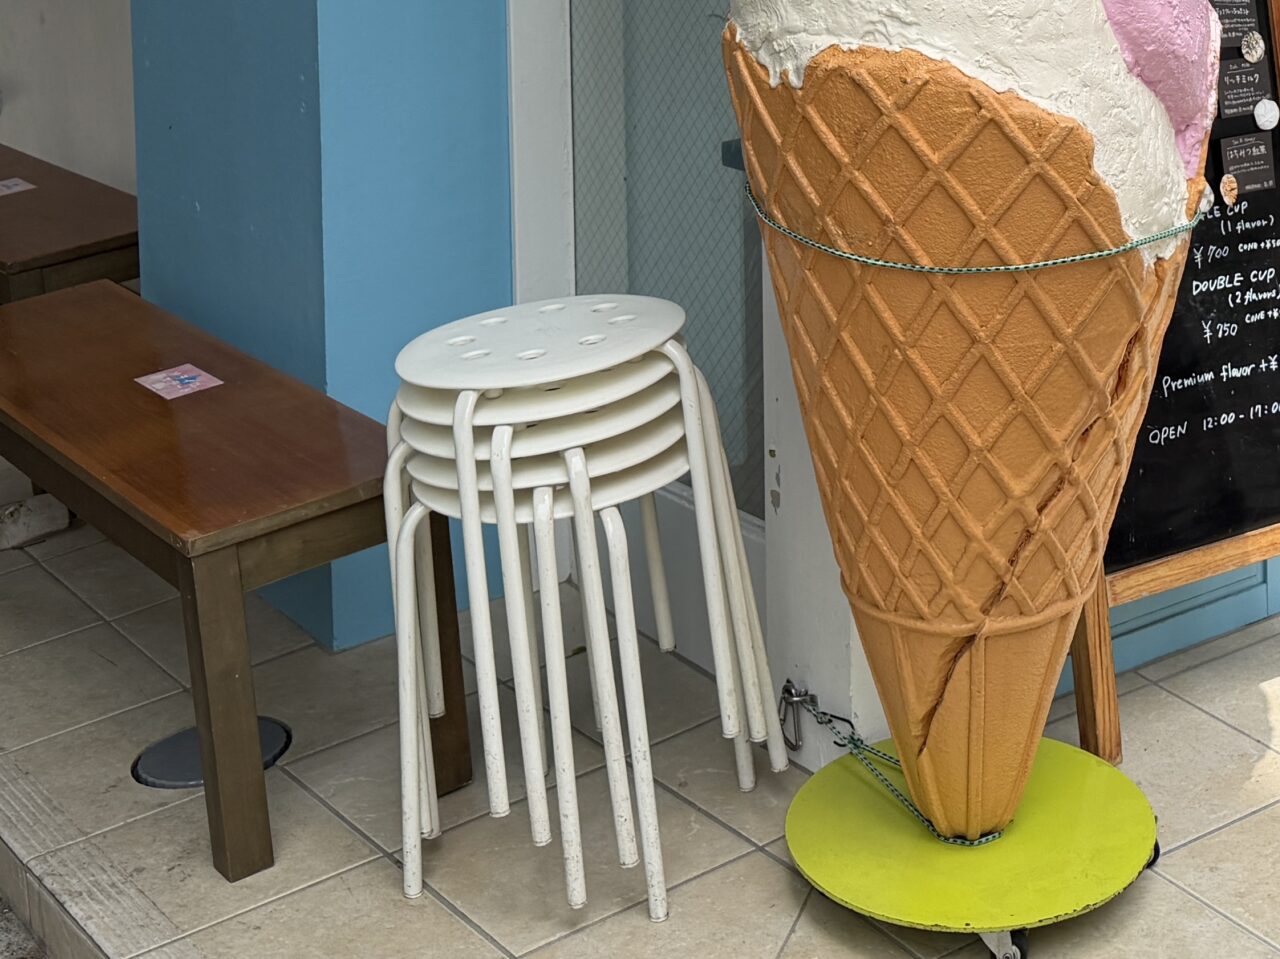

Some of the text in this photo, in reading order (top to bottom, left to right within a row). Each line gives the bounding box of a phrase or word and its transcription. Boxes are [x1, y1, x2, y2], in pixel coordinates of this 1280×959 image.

[1226, 201, 1248, 216] CUP
[1192, 267, 1276, 296] DOUBLE CUP
[1162, 370, 1215, 397] Premium
[1219, 362, 1256, 382] flavor
[1148, 421, 1188, 446] OPEN
[1203, 411, 1236, 431] 12:00
